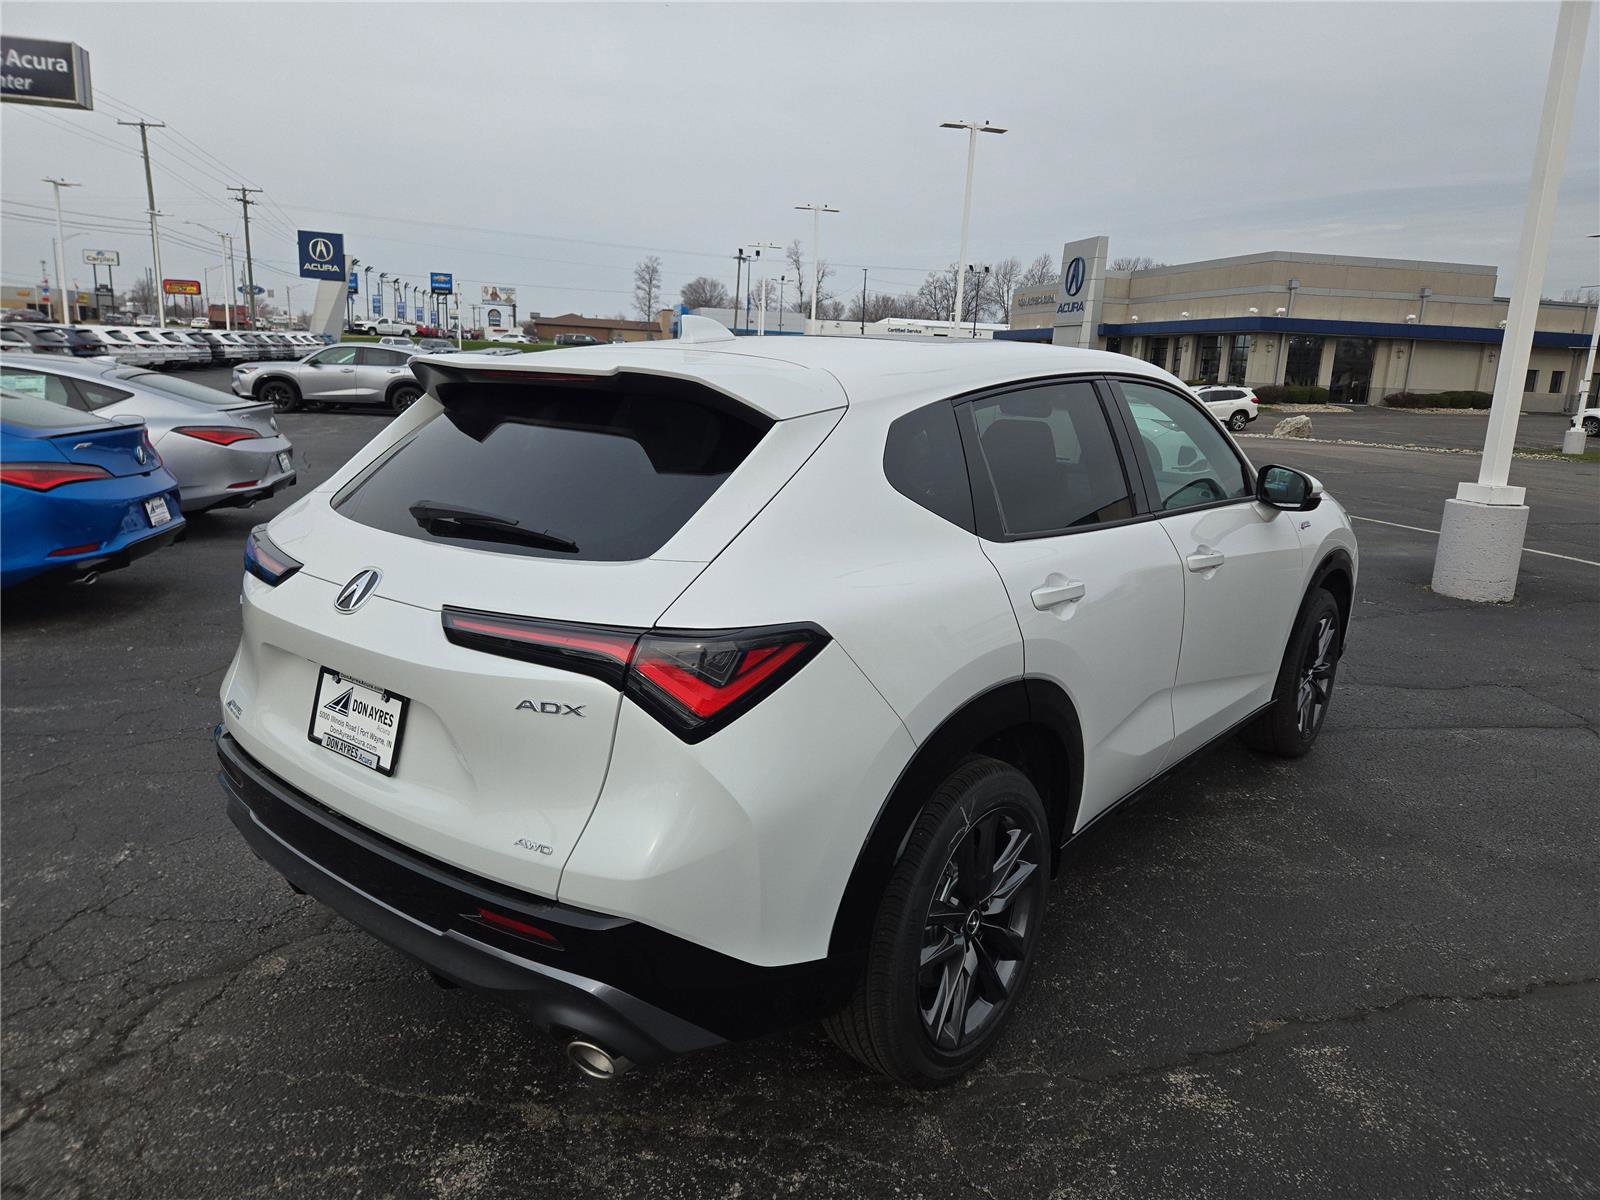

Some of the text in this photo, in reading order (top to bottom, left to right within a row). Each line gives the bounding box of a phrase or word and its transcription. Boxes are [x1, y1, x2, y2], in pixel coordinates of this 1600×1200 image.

[5, 48, 68, 73] Acura
[303, 262, 340, 273] ACURA
[1056, 301, 1085, 314] ACURA
[514, 699, 587, 718] ADX
[345, 721, 357, 733] Road
[360, 727, 369, 738] Fort
[358, 753, 373, 766] Acura
[512, 838, 554, 856] AWD
